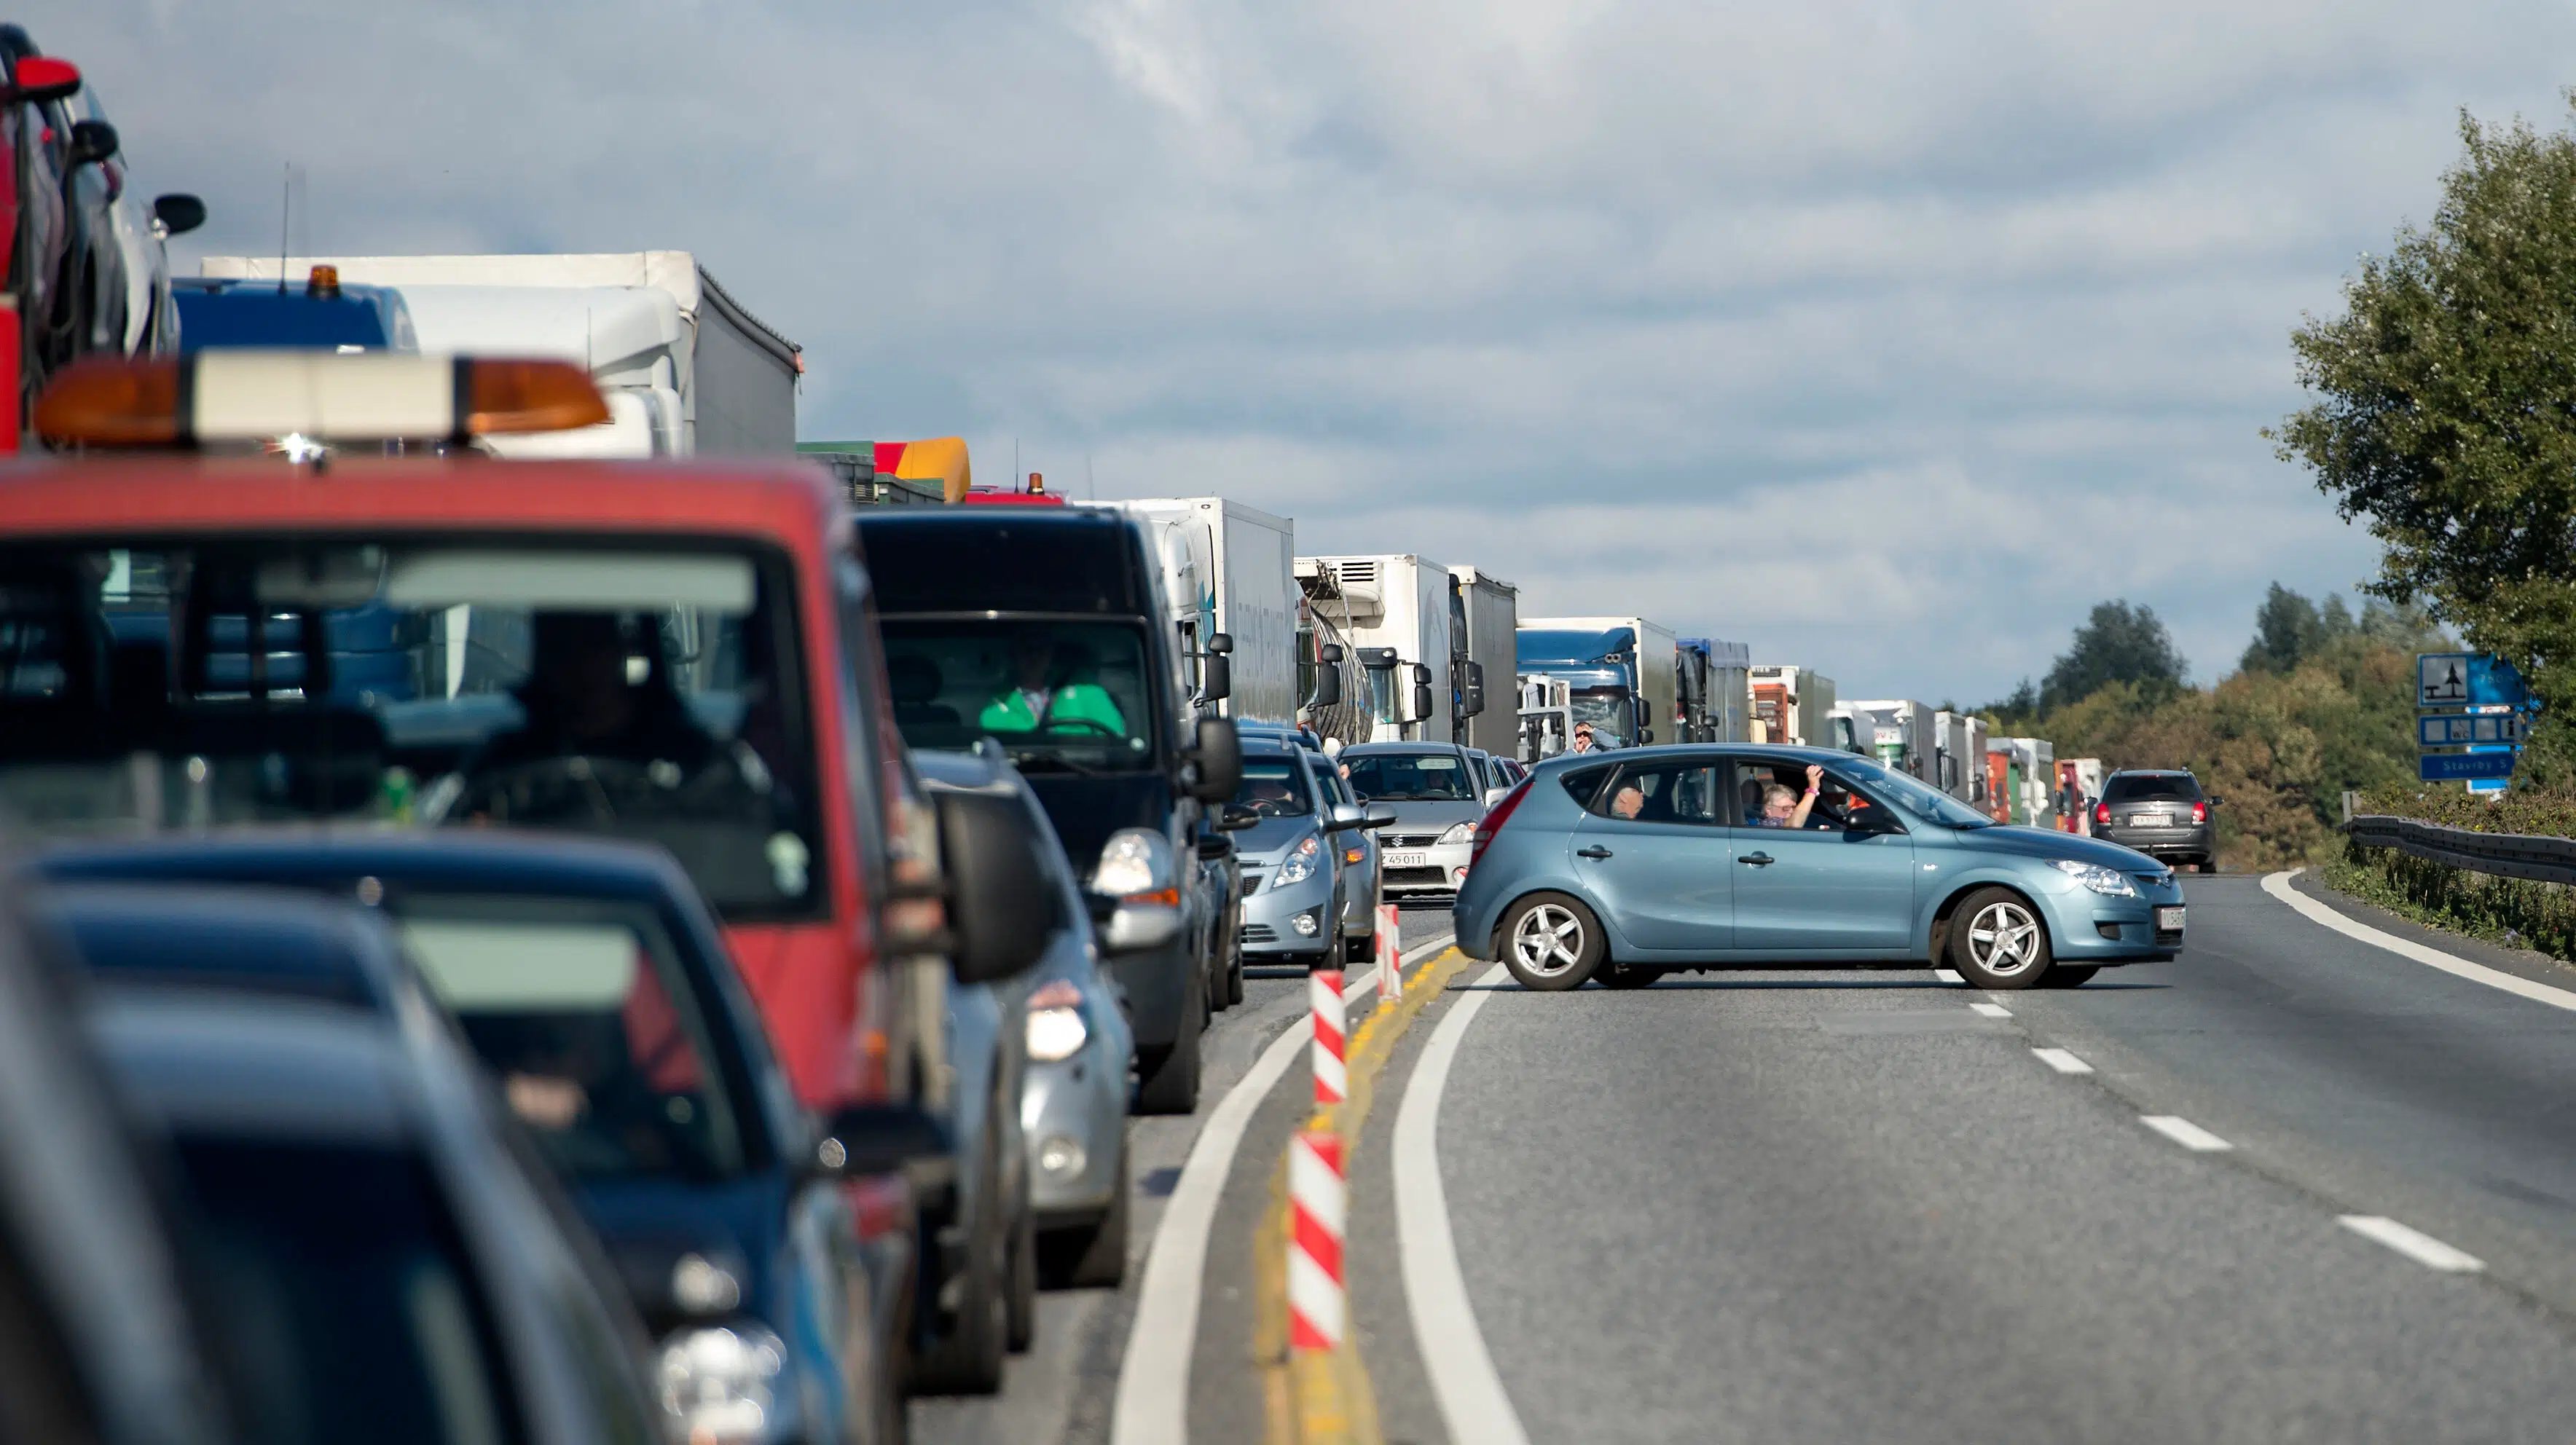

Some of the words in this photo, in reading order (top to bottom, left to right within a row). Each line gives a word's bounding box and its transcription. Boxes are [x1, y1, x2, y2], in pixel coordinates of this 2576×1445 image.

[2452, 731, 2470, 739] WC
[1389, 856, 1402, 864] 45
[1404, 855, 1421, 864] 011
